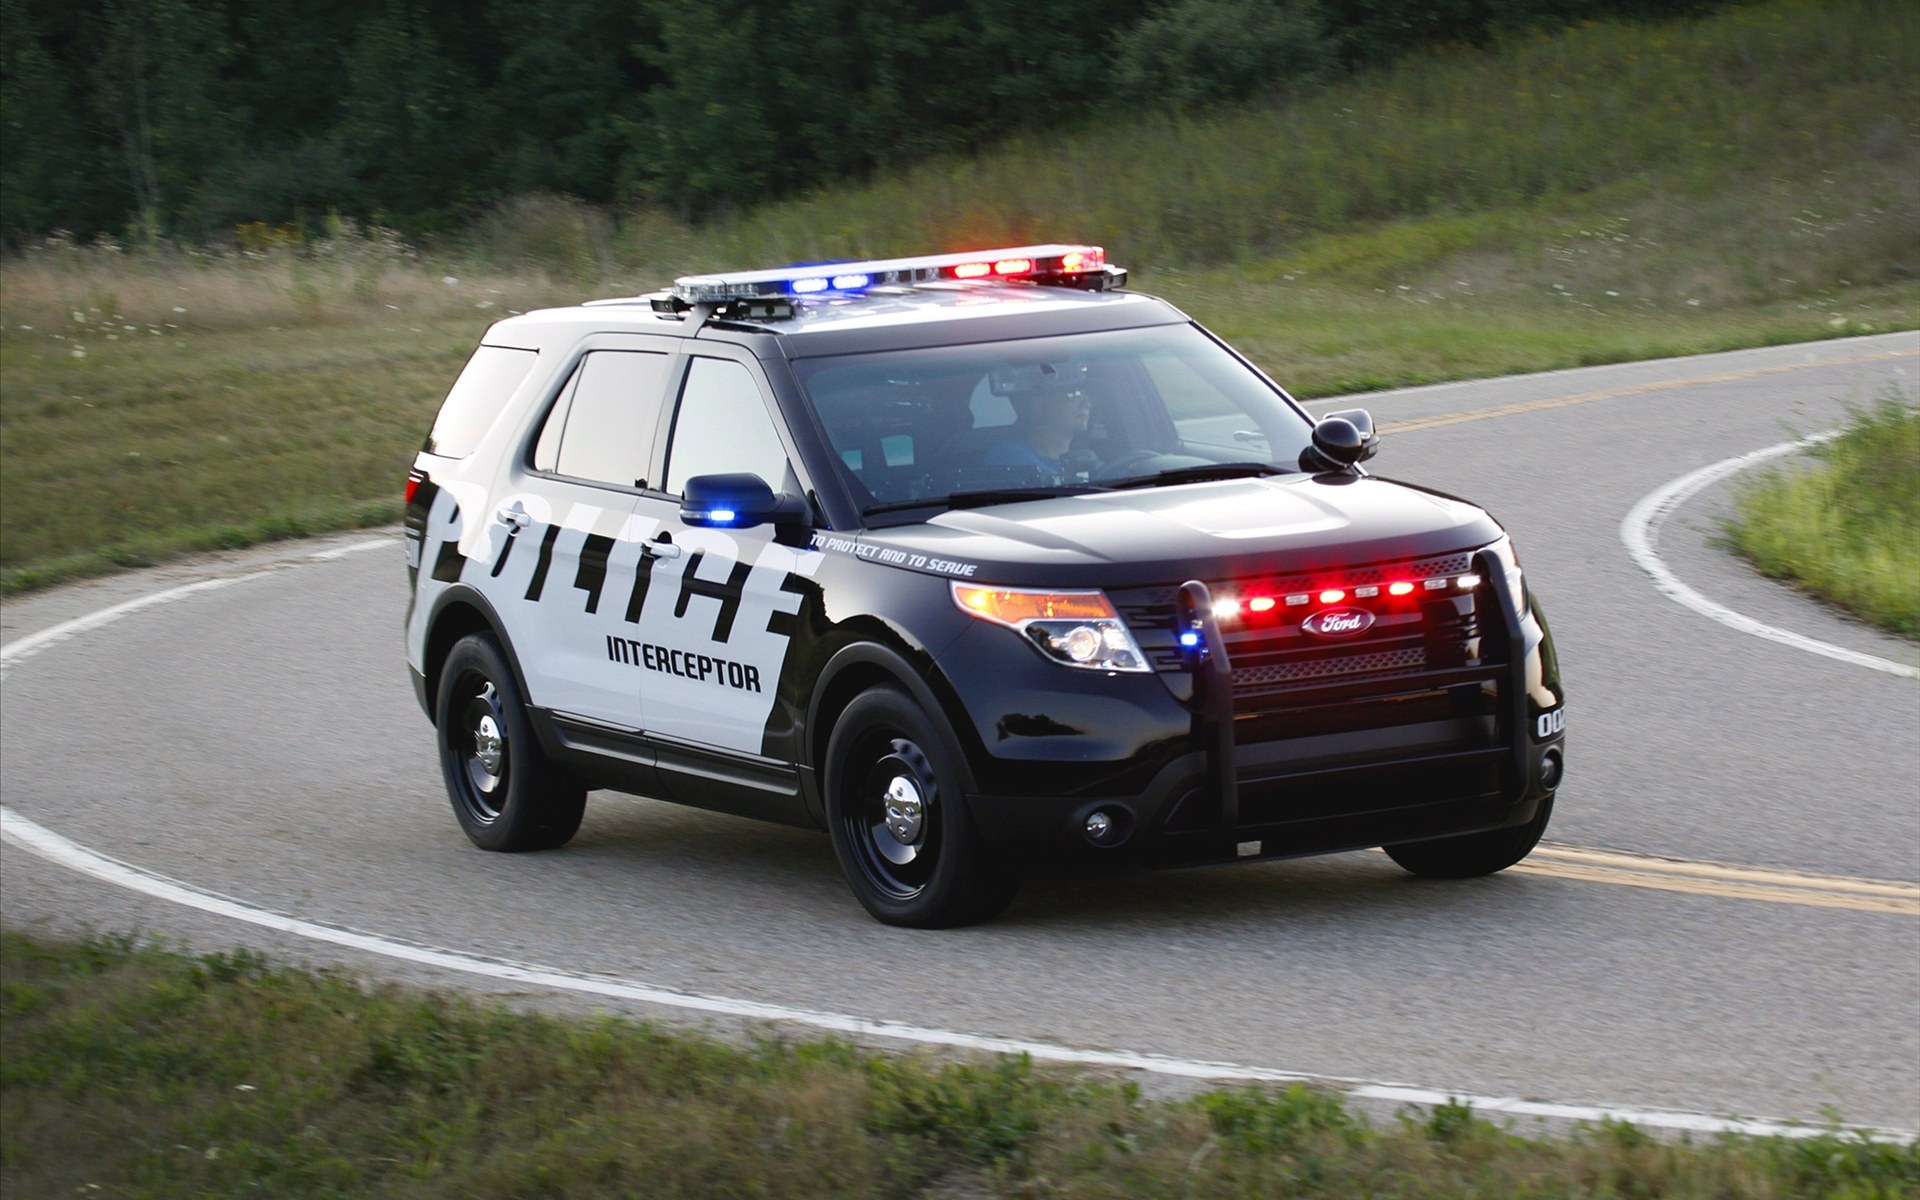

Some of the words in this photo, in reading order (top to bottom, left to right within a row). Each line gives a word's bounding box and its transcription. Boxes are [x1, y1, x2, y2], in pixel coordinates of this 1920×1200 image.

[424, 478, 826, 645] POLICE
[810, 533, 825, 546] TO
[827, 538, 876, 558] PROTECT
[879, 549, 906, 564] AND
[906, 555, 927, 568] TO
[927, 559, 978, 576] SERVE
[1321, 612, 1361, 632] Ford
[606, 635, 761, 693] INTERCEPTOR
